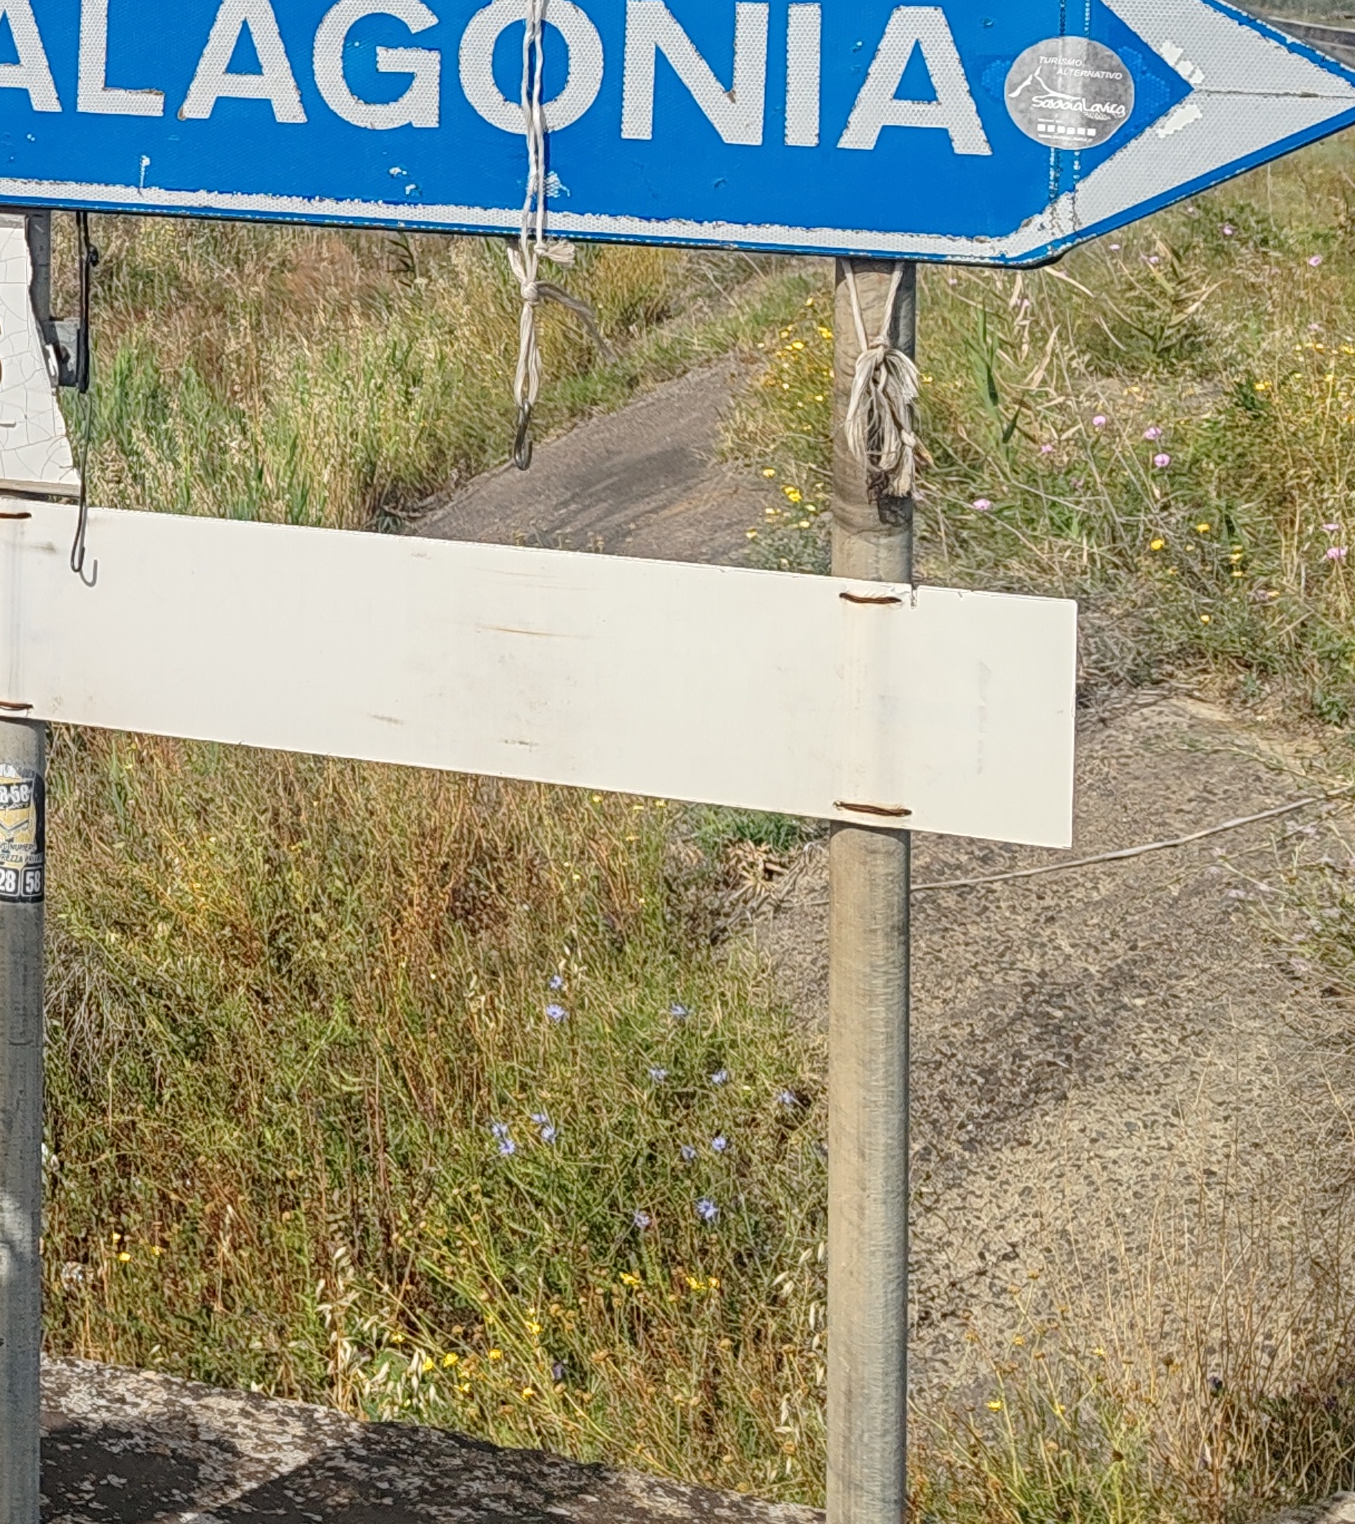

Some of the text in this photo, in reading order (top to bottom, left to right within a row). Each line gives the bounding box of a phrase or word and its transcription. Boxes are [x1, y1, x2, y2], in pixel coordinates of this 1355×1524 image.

[1039, 56, 1083, 67] TURISMO
[1056, 67, 1123, 81] ALTERNATIVO
[25, 870, 41, 894] 58
